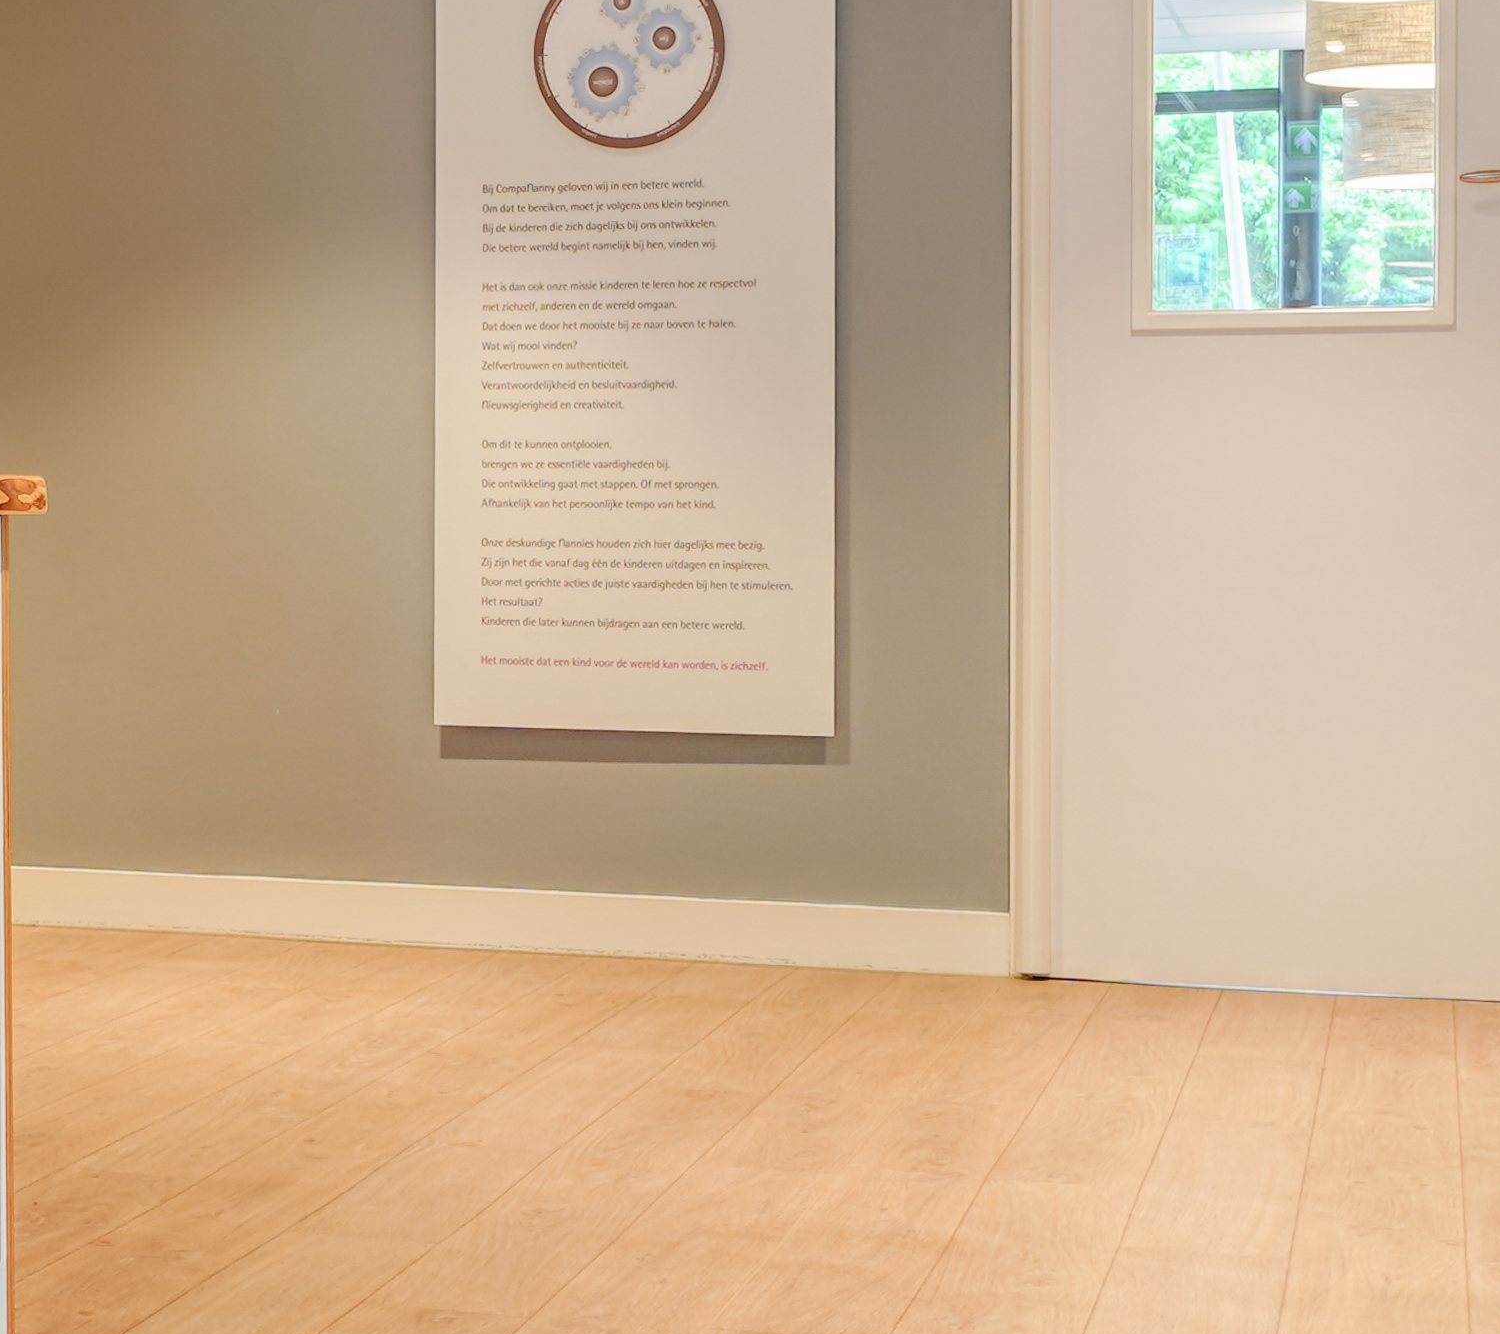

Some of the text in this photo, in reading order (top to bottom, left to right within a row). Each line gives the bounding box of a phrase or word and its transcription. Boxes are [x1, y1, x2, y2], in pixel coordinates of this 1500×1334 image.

[483, 184, 494, 196] Bij
[558, 183, 592, 194] geloven
[595, 182, 608, 193] wij
[611, 181, 620, 190] in
[622, 183, 638, 191] een
[640, 181, 669, 190] betere
[482, 204, 498, 213] Om
[500, 204, 515, 213] dat
[518, 205, 526, 213] te
[571, 203, 594, 211] moet
[595, 201, 604, 213] je
[606, 201, 642, 213] volgens
[643, 202, 660, 210] ons
[662, 200, 683, 209] klein
[482, 224, 494, 235] Bij
[496, 224, 506, 233] de
[509, 223, 547, 233] kinderen
[550, 222, 563, 232] die
[565, 222, 584, 231] zich
[586, 221, 625, 233] dagelijks
[627, 220, 638, 232] bij
[640, 222, 657, 230] ons
[482, 244, 496, 253] Die
[499, 244, 527, 253] betere
[529, 242, 558, 252] wereld
[561, 242, 590, 253] begint
[592, 240, 630, 252] namelijk
[633, 240, 644, 252] bij
[668, 240, 699, 249] vinden
[482, 283, 498, 292] Het
[500, 283, 507, 292] is
[509, 283, 526, 292] dan
[528, 283, 544, 291] ook
[570, 282, 597, 291] missie
[600, 281, 638, 290] kinderen
[642, 281, 650, 290] te
[653, 280, 676, 289] leren
[678, 280, 695, 289] hoe
[698, 281, 707, 289] ze
[710, 279, 756, 290] respectvol
[482, 304, 499, 312] met
[540, 302, 576, 311] anderen
[578, 303, 590, 311] en
[592, 301, 603, 310] de
[605, 300, 636, 310] wereld
[482, 322, 498, 331] Dat
[500, 322, 522, 331] doen
[540, 322, 560, 331] door
[563, 321, 578, 330] het
[580, 321, 616, 330] mooiste
[618, 321, 629, 332] bij
[667, 320, 694, 329] boven
[698, 321, 706, 329] te
[482, 342, 500, 351] Wat
[502, 342, 515, 353] wij
[518, 342, 540, 351] mooi
[482, 361, 550, 371] Zelfvertrouwen
[482, 381, 576, 391] Verantwoordelijkheid
[482, 479, 496, 489] Die
[498, 480, 556, 491] ontwikkeling
[558, 481, 578, 491] gaat
[581, 481, 598, 489] met
[641, 479, 652, 489] Of
[654, 481, 672, 489] met
[481, 499, 532, 510] Afhankelijk
[552, 499, 567, 509] het
[570, 500, 623, 511] persoonlijke
[626, 501, 655, 511] tempo
[676, 500, 692, 509] het
[481, 538, 504, 547] Onze
[506, 539, 556, 550] deskundige
[596, 539, 630, 549] houden
[633, 539, 651, 549] zich
[654, 540, 672, 549] hier
[674, 540, 714, 552] dagelijks
[482, 577, 503, 587] Door
[505, 579, 522, 587] met
[524, 578, 562, 589] gerichte
[564, 579, 590, 588] acties
[592, 579, 603, 588] de
[604, 579, 630, 590] juiste
[632, 580, 694, 591] vaardigheden
[696, 580, 708, 592] bij
[710, 581, 728, 590] hen
[730, 582, 739, 590] te
[482, 617, 520, 626] Kinderen
[523, 617, 536, 627] die
[539, 618, 559, 627] later
[562, 618, 595, 627] kunnen
[598, 619, 640, 630] bijdragen
[680, 621, 710, 630] betere
[481, 656, 497, 665] Het
[499, 657, 534, 666] mooiste
[536, 657, 551, 666] dat
[572, 658, 591, 667] kind
[616, 659, 628, 668] de
[630, 660, 660, 669] wereld
[663, 660, 679, 669] kan
[721, 661, 728, 670] is
